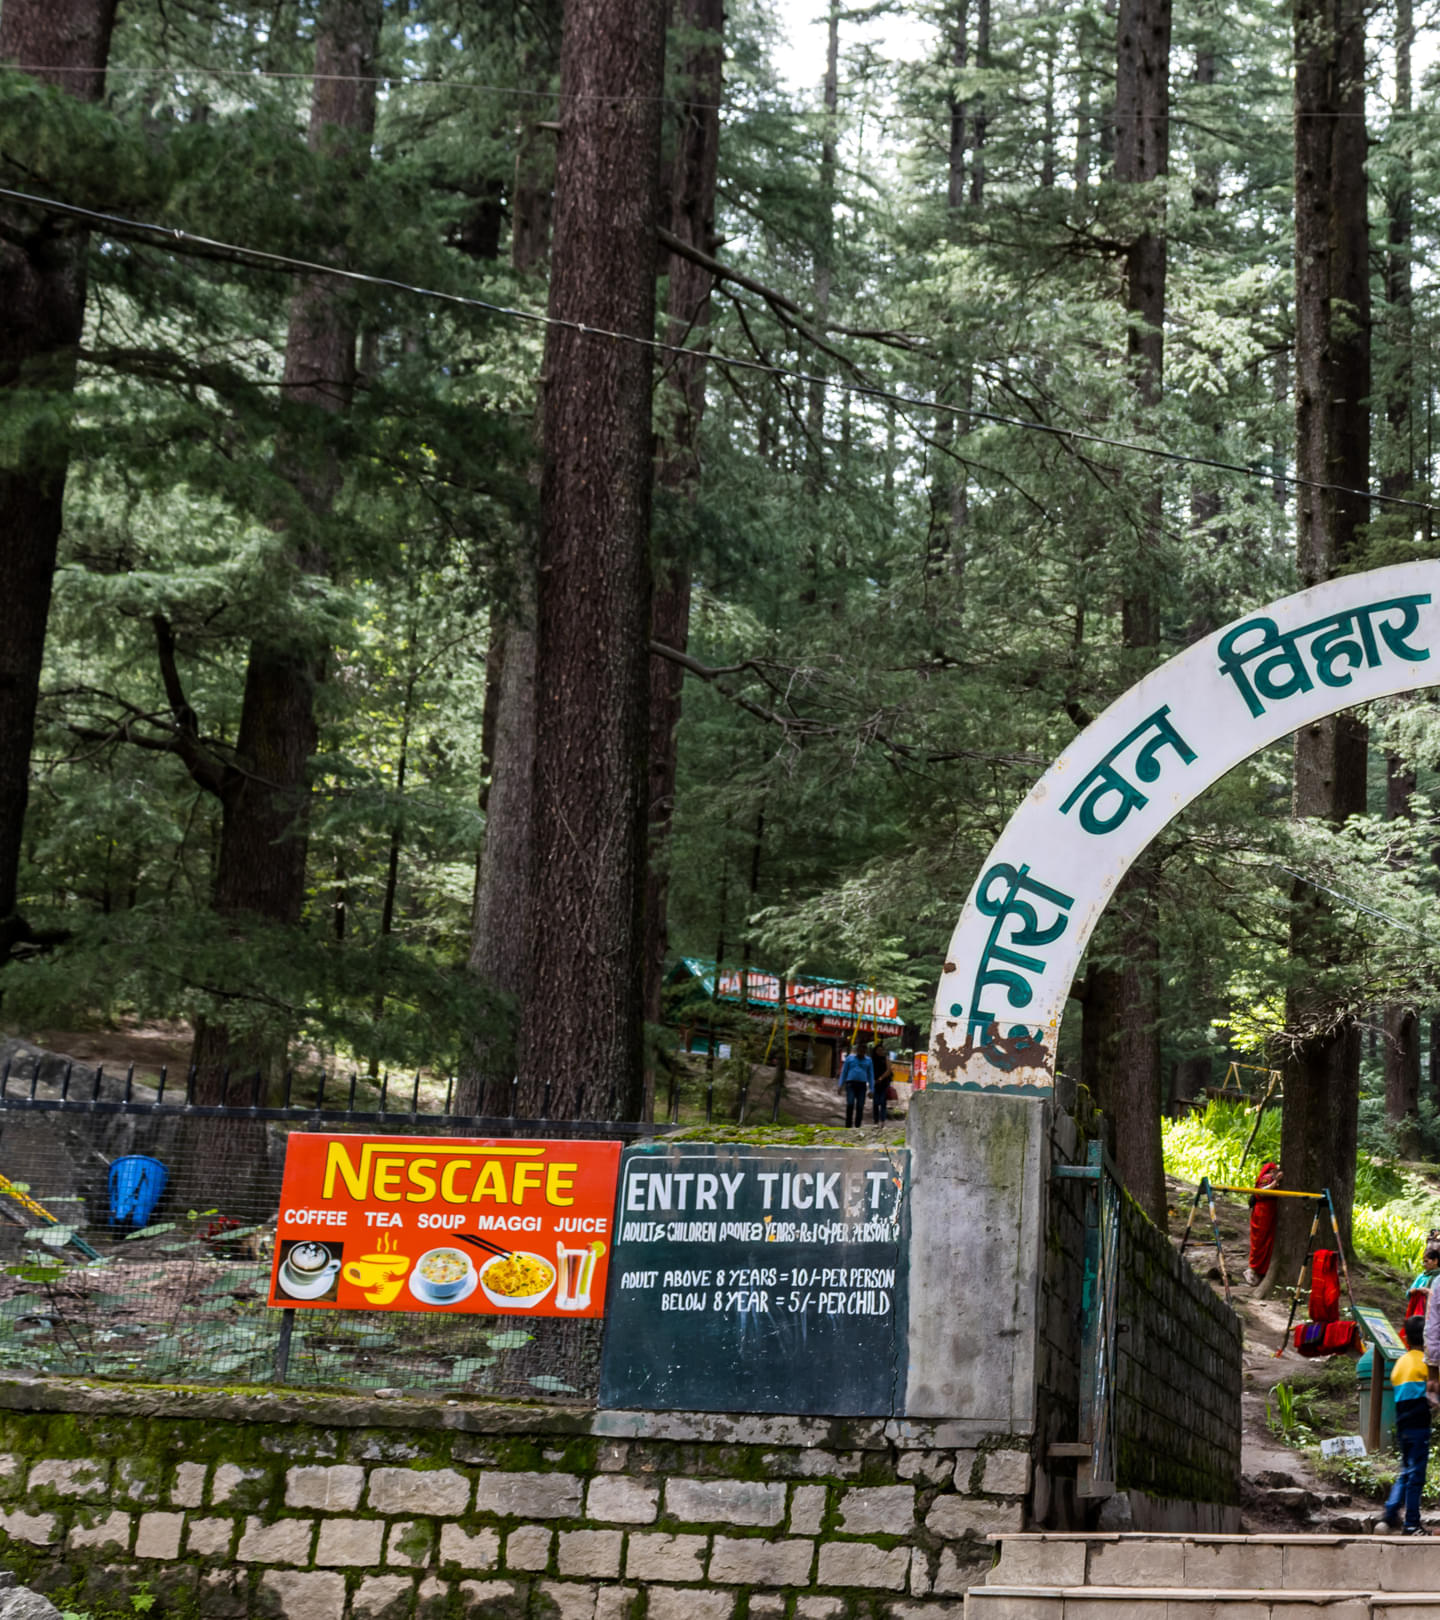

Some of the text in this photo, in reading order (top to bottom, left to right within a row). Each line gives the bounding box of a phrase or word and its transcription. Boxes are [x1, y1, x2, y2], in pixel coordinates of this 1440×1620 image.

[1058, 704, 1199, 835] वन
[1217, 593, 1432, 719] विहार
[794, 985, 853, 1010] COFFEE
[855, 989, 895, 1016] SHOP
[322, 1141, 579, 1207] NESCAFE
[627, 1172, 746, 1211] ENTRY
[283, 1208, 607, 1234] COFFEE TEA SOUP MAGGI JUICE
[667, 1221, 717, 1242] CHILDREN
[621, 1271, 658, 1289] ADULT
[663, 1269, 713, 1288] ABOVE
[716, 1269, 725, 1287] 8
[727, 1268, 777, 1287] YEARS
[850, 1268, 895, 1289] PERSON
[661, 1292, 706, 1312] BELOW
[724, 1290, 769, 1313] YEAR
